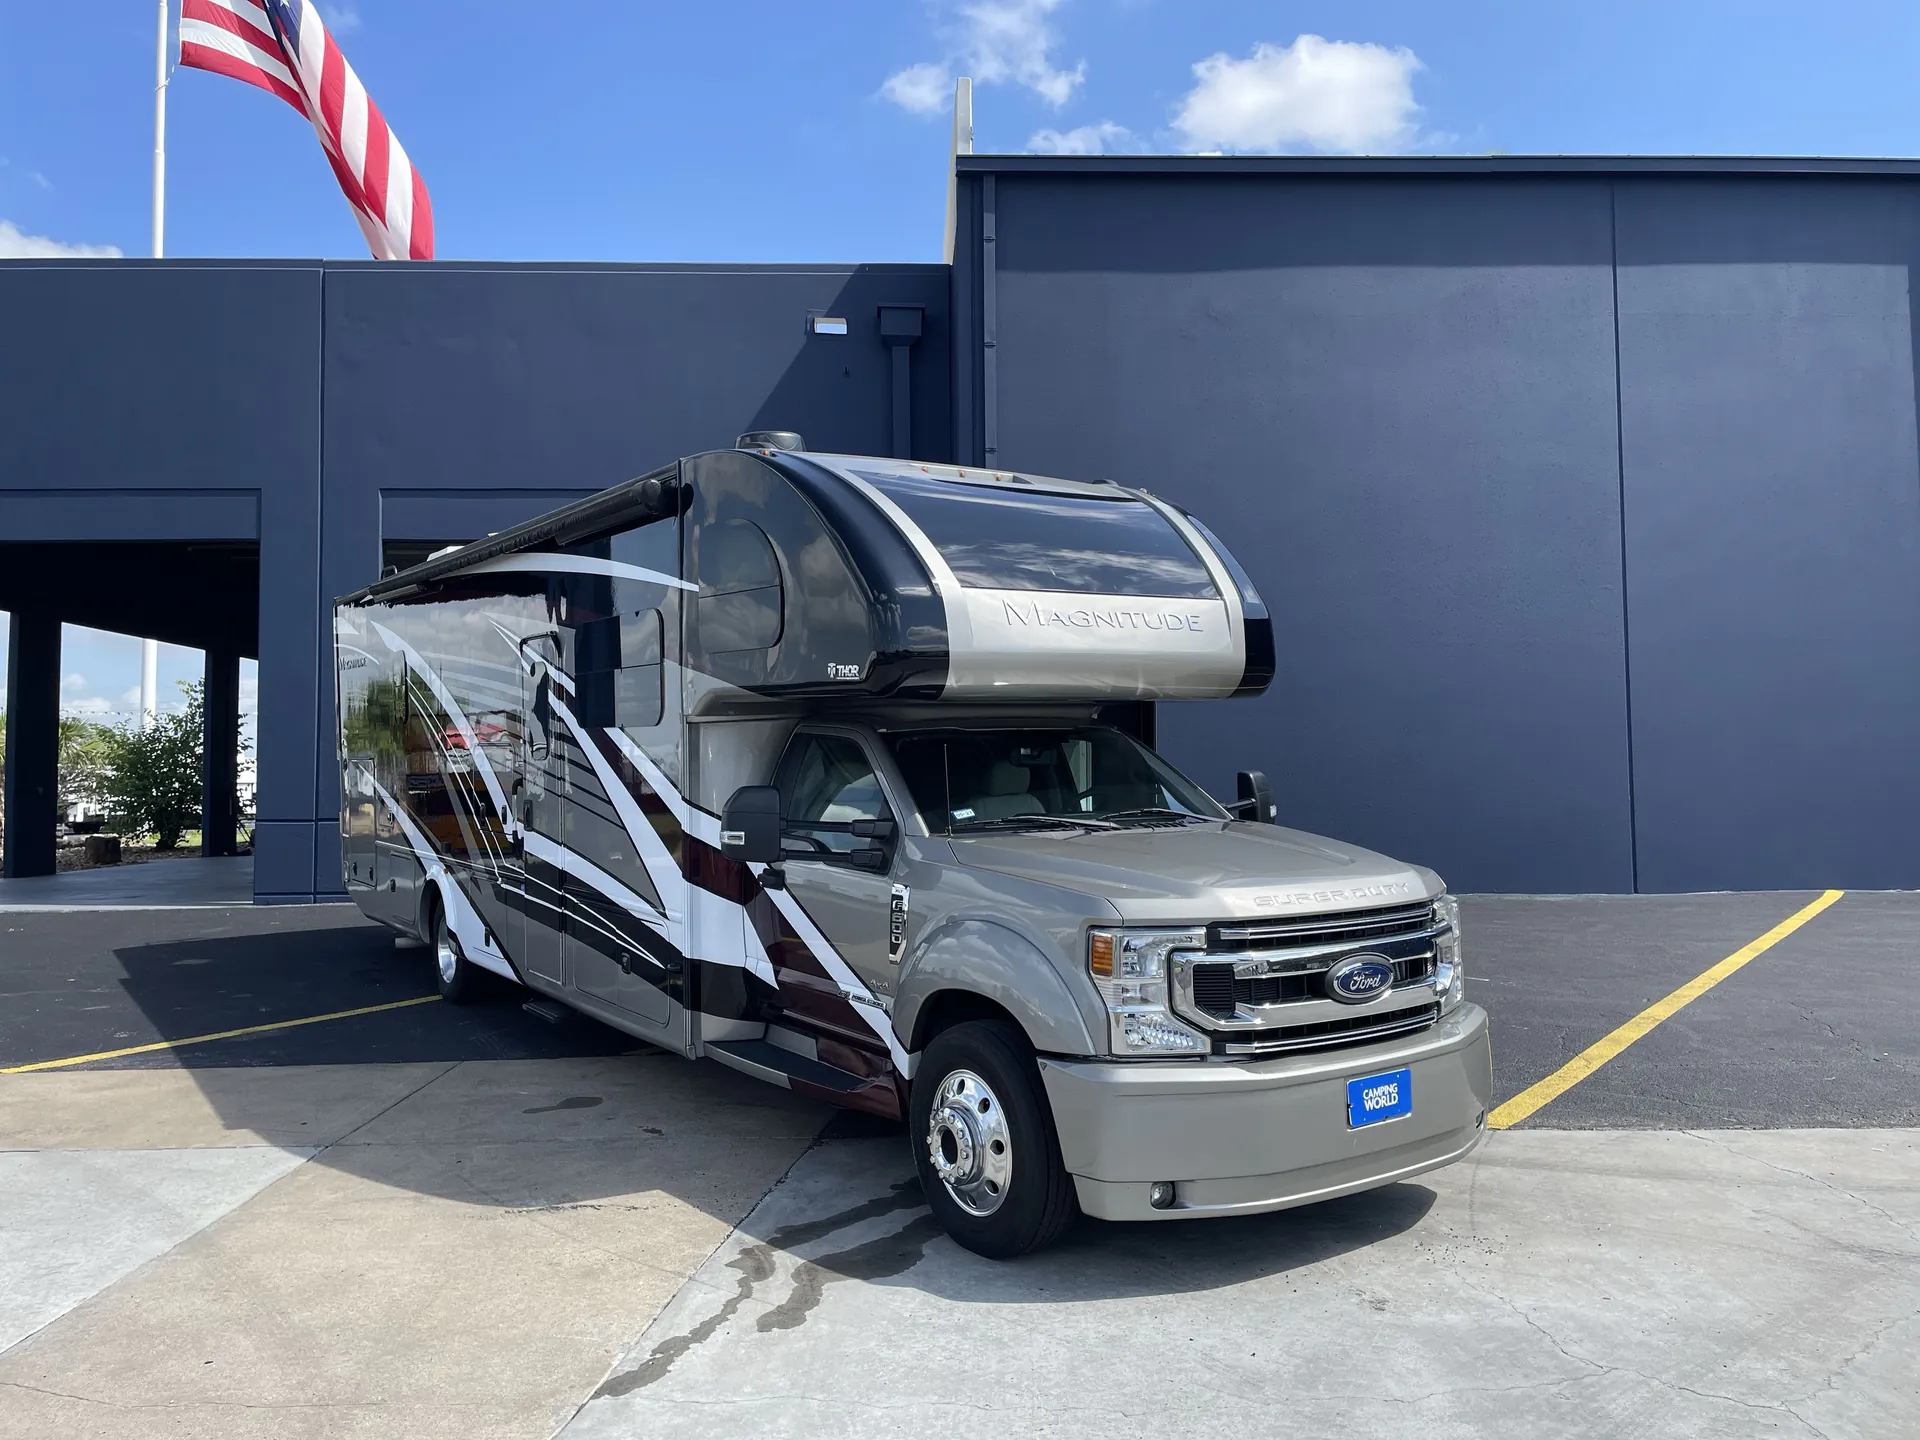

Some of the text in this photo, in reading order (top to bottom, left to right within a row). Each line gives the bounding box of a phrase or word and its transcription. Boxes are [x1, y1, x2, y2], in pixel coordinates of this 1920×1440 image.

[1002, 599, 1203, 632] MAGNITUDE
[836, 664, 860, 677] THOR
[1253, 882, 1410, 908] SUPER DUTY
[1349, 969, 1382, 991] Ford
[1362, 1082, 1398, 1100] CAMPING
[1364, 1093, 1399, 1112] WORLD
